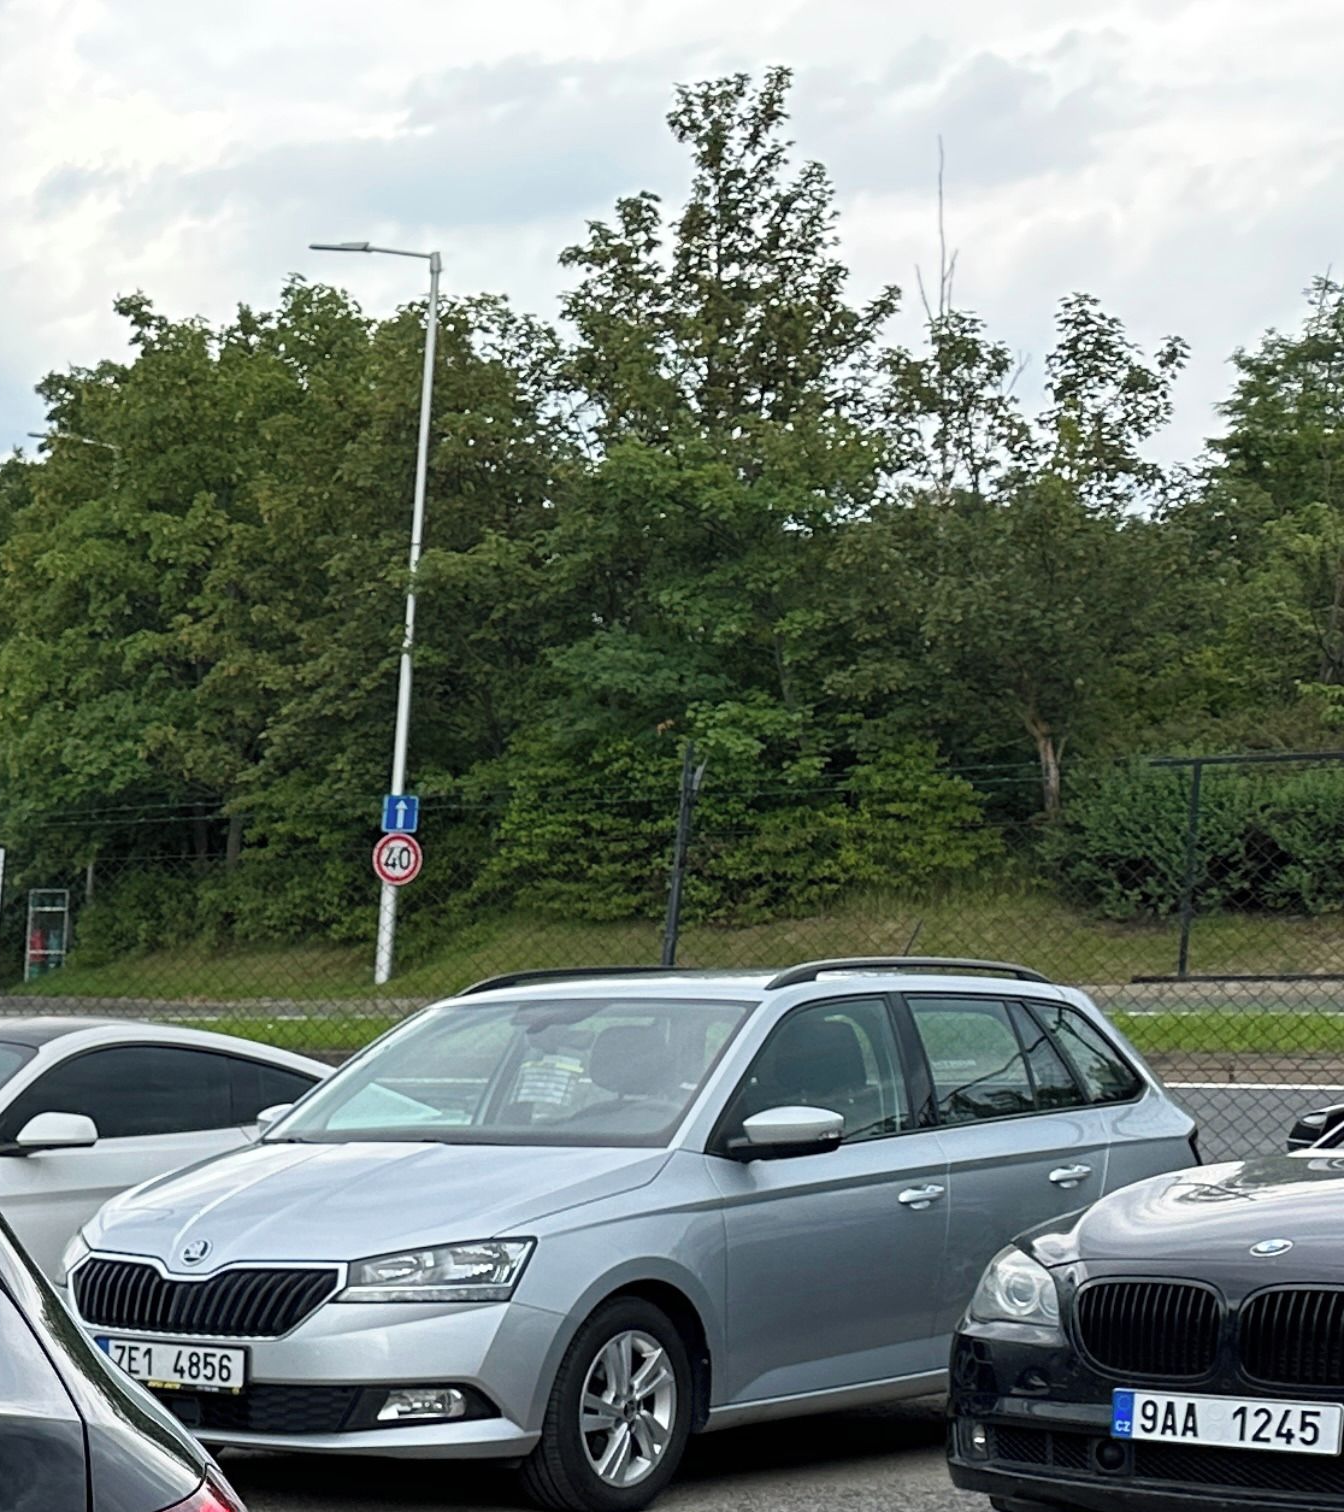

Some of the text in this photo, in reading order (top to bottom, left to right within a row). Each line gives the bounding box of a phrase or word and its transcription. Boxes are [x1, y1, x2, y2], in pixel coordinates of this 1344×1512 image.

[384, 847, 411, 870] 40
[173, 1350, 232, 1382] 4856
[1115, 1420, 1130, 1432] CZ
[1140, 1400, 1321, 1446] 9AA 1245
